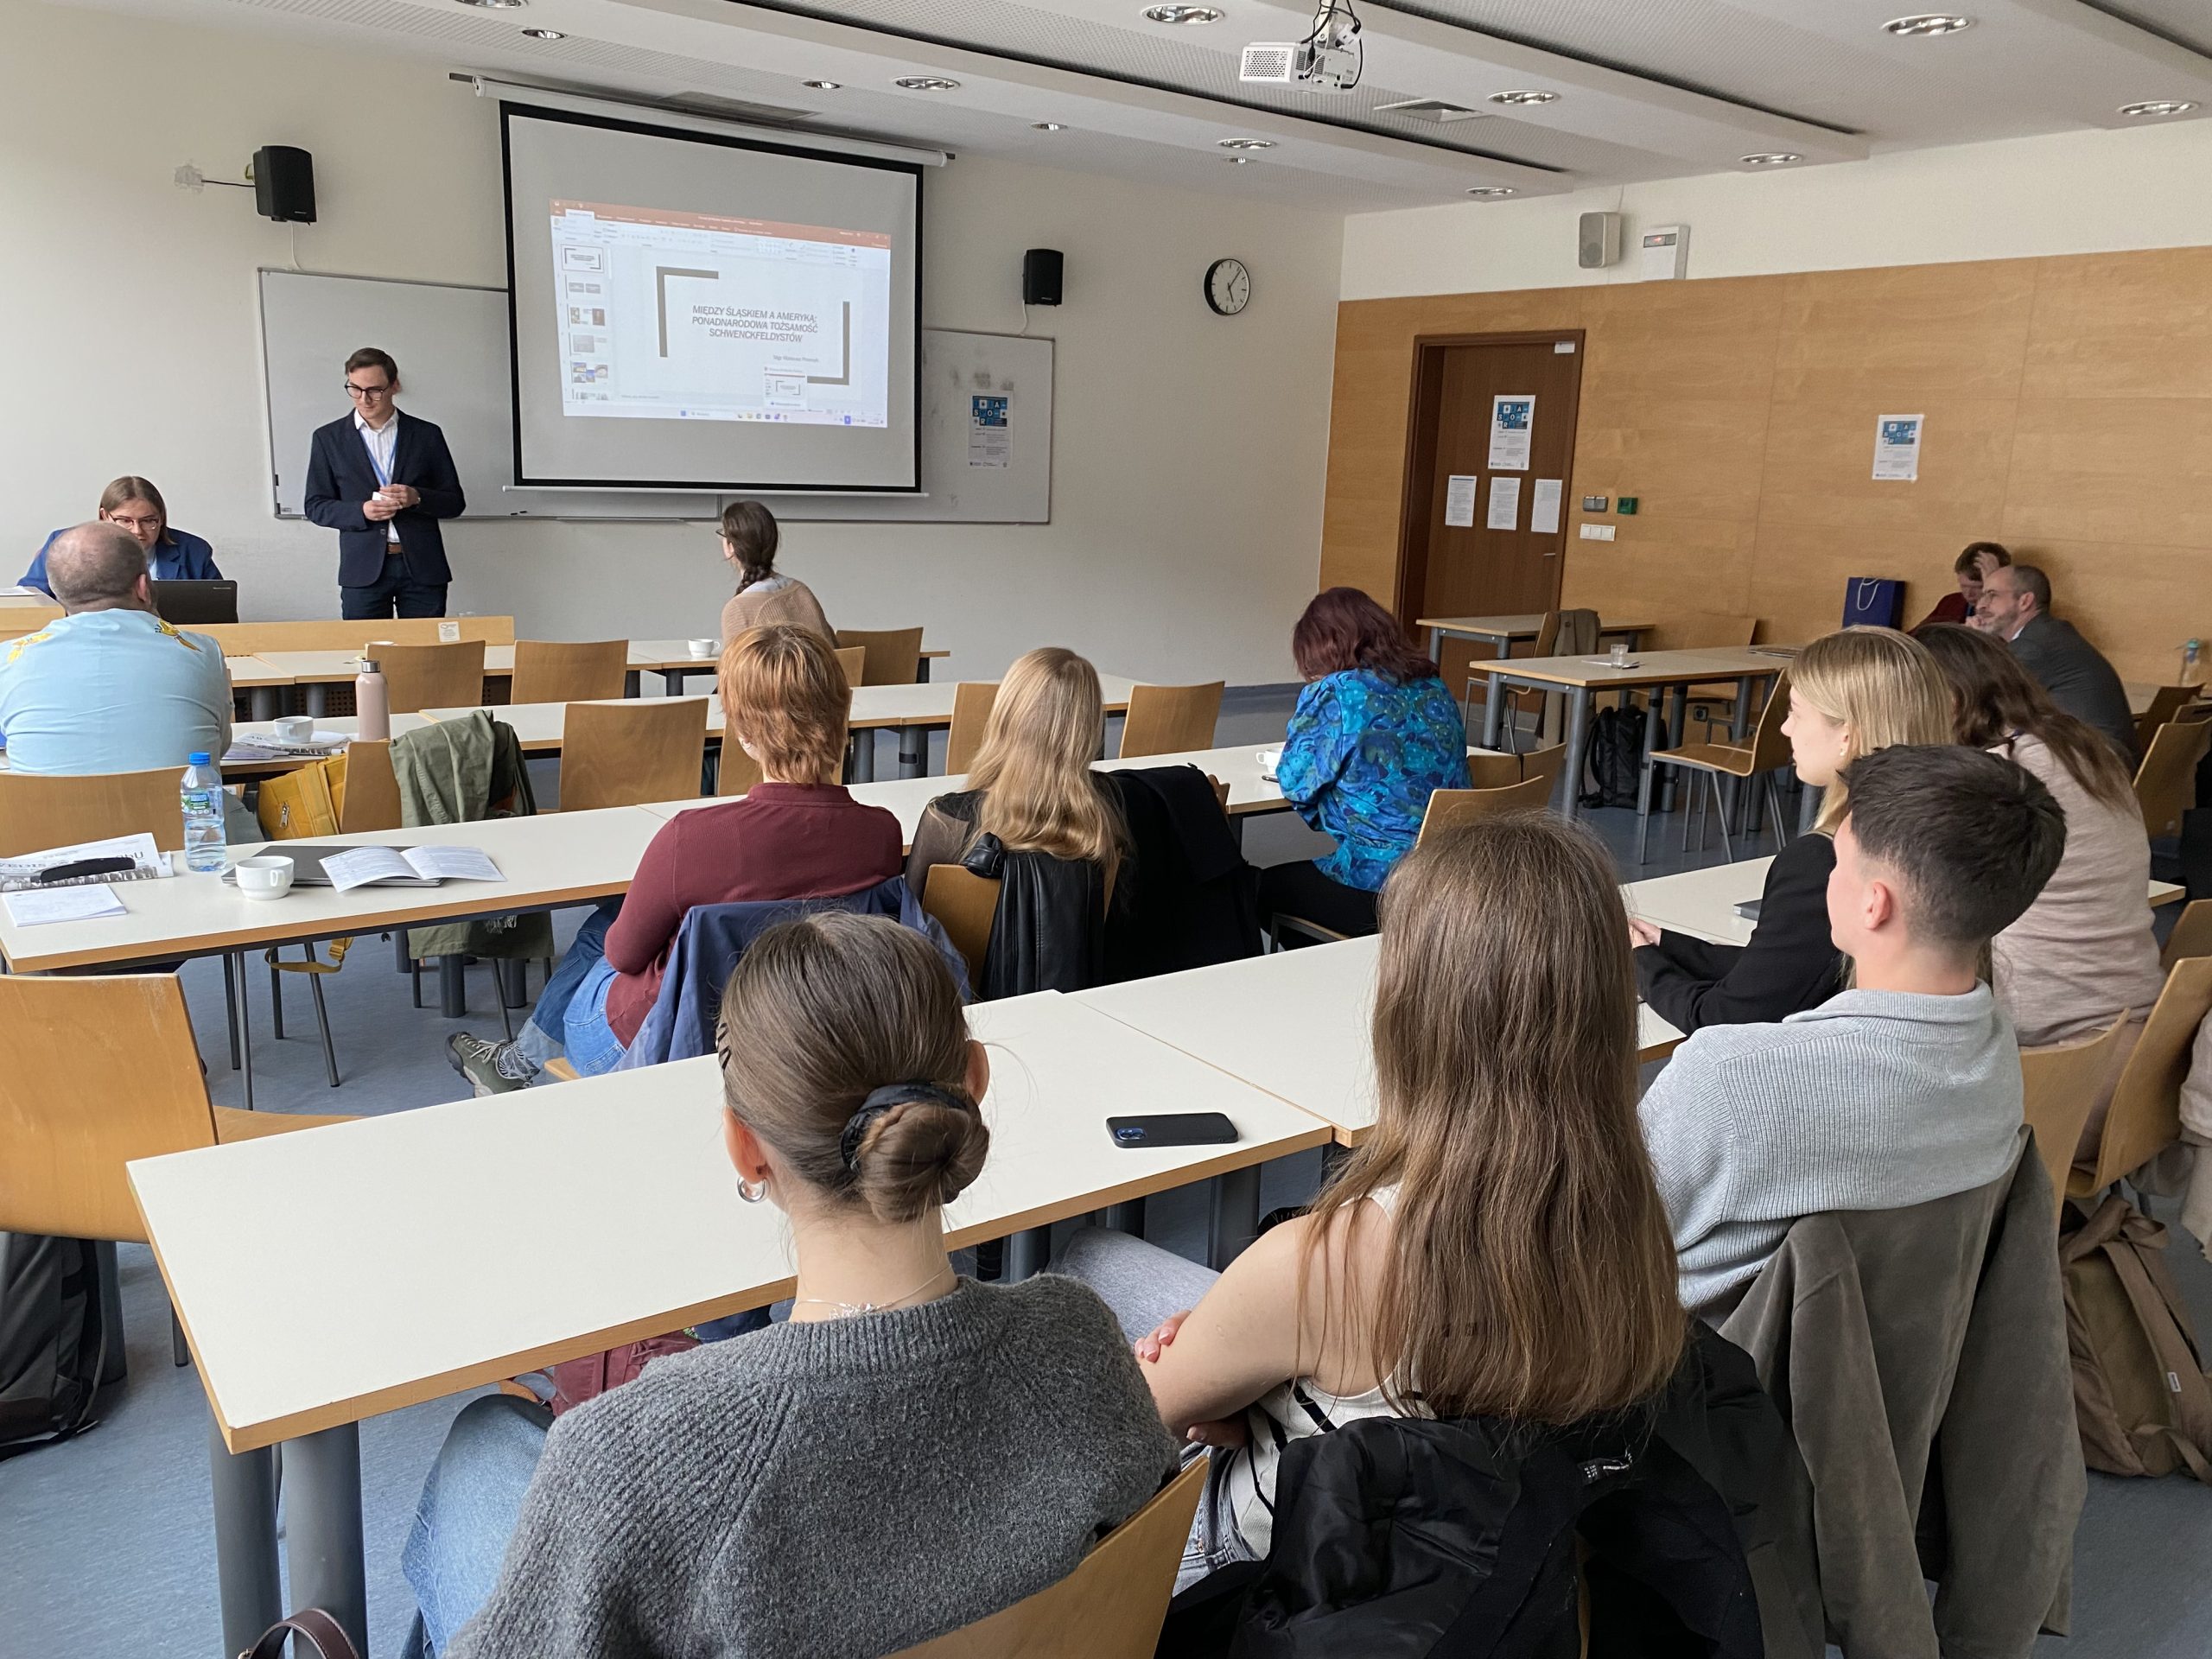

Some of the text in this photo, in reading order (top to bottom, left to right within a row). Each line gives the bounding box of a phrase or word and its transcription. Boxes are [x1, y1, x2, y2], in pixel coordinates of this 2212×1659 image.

[692, 305, 724, 316] MIĘDZY
[726, 306, 767, 319] ŚLĄSKIEM
[692, 316, 818, 333] PONADNARODOWA TOŻSAMOŚĆ
[709, 328, 803, 342] SCHWENCKFELDYSTÓW
